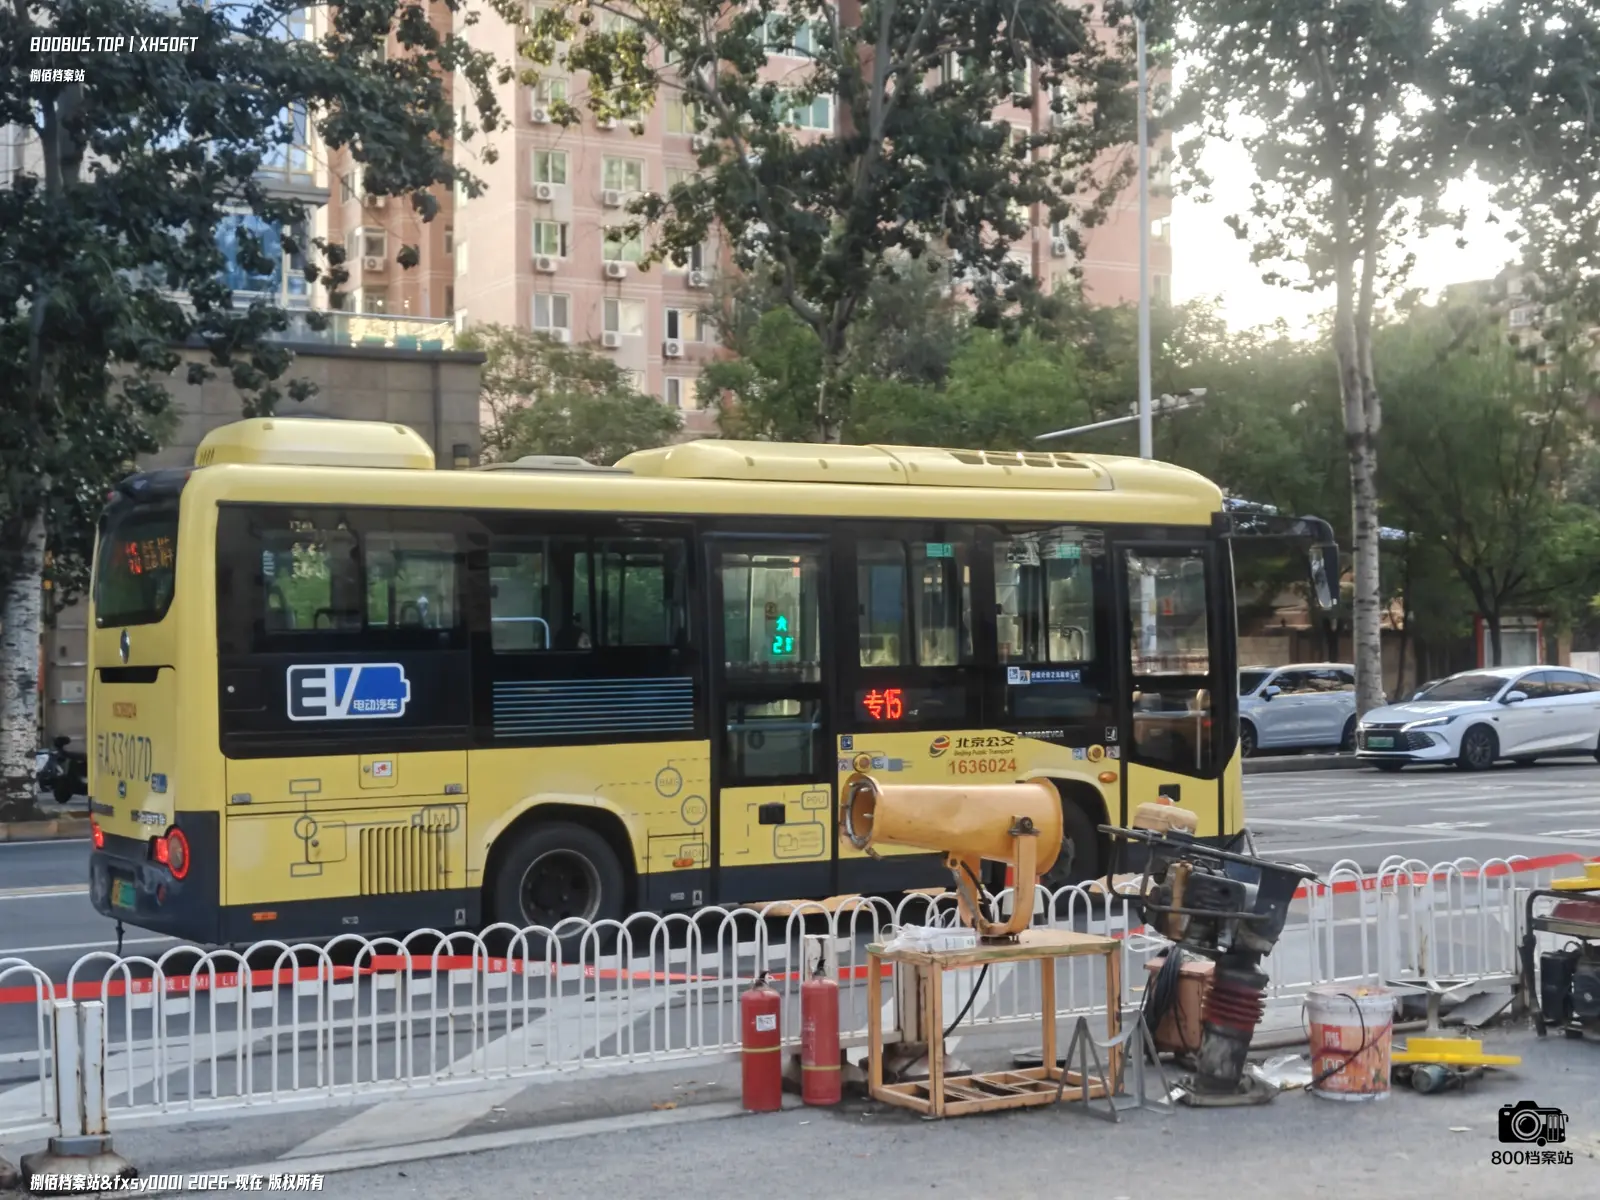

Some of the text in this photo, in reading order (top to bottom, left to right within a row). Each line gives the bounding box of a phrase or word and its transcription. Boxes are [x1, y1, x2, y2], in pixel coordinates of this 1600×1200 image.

[287, 664, 362, 721] EV
[353, 699, 398, 711] 电动汽车
[864, 689, 902, 719] 专15
[955, 736, 1015, 748] 北京公交
[949, 758, 1017, 775] 1636024
[434, 813, 446, 824] M
[181, 974, 212, 989] LMI
